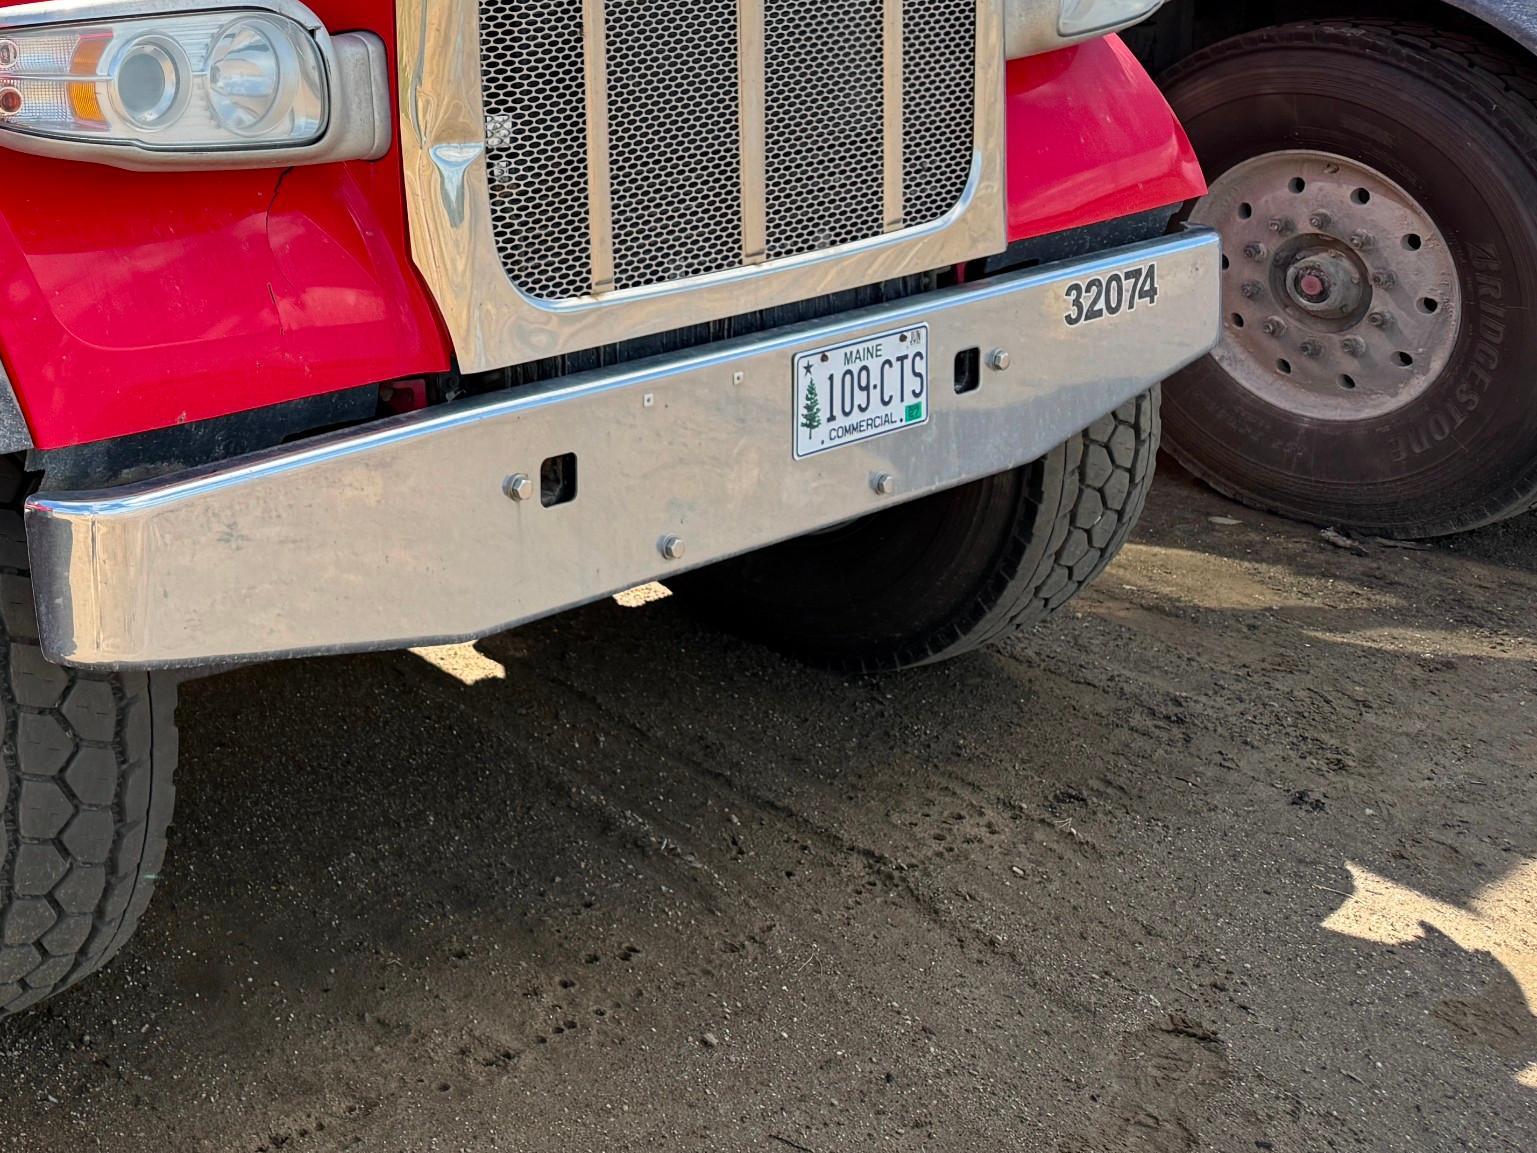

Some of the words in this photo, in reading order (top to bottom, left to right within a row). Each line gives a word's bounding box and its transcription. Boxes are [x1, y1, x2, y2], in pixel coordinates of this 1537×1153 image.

[1064, 262, 1158, 327] 32074
[844, 343, 884, 367] MAINE
[828, 412, 897, 441] COMMERCIAL
